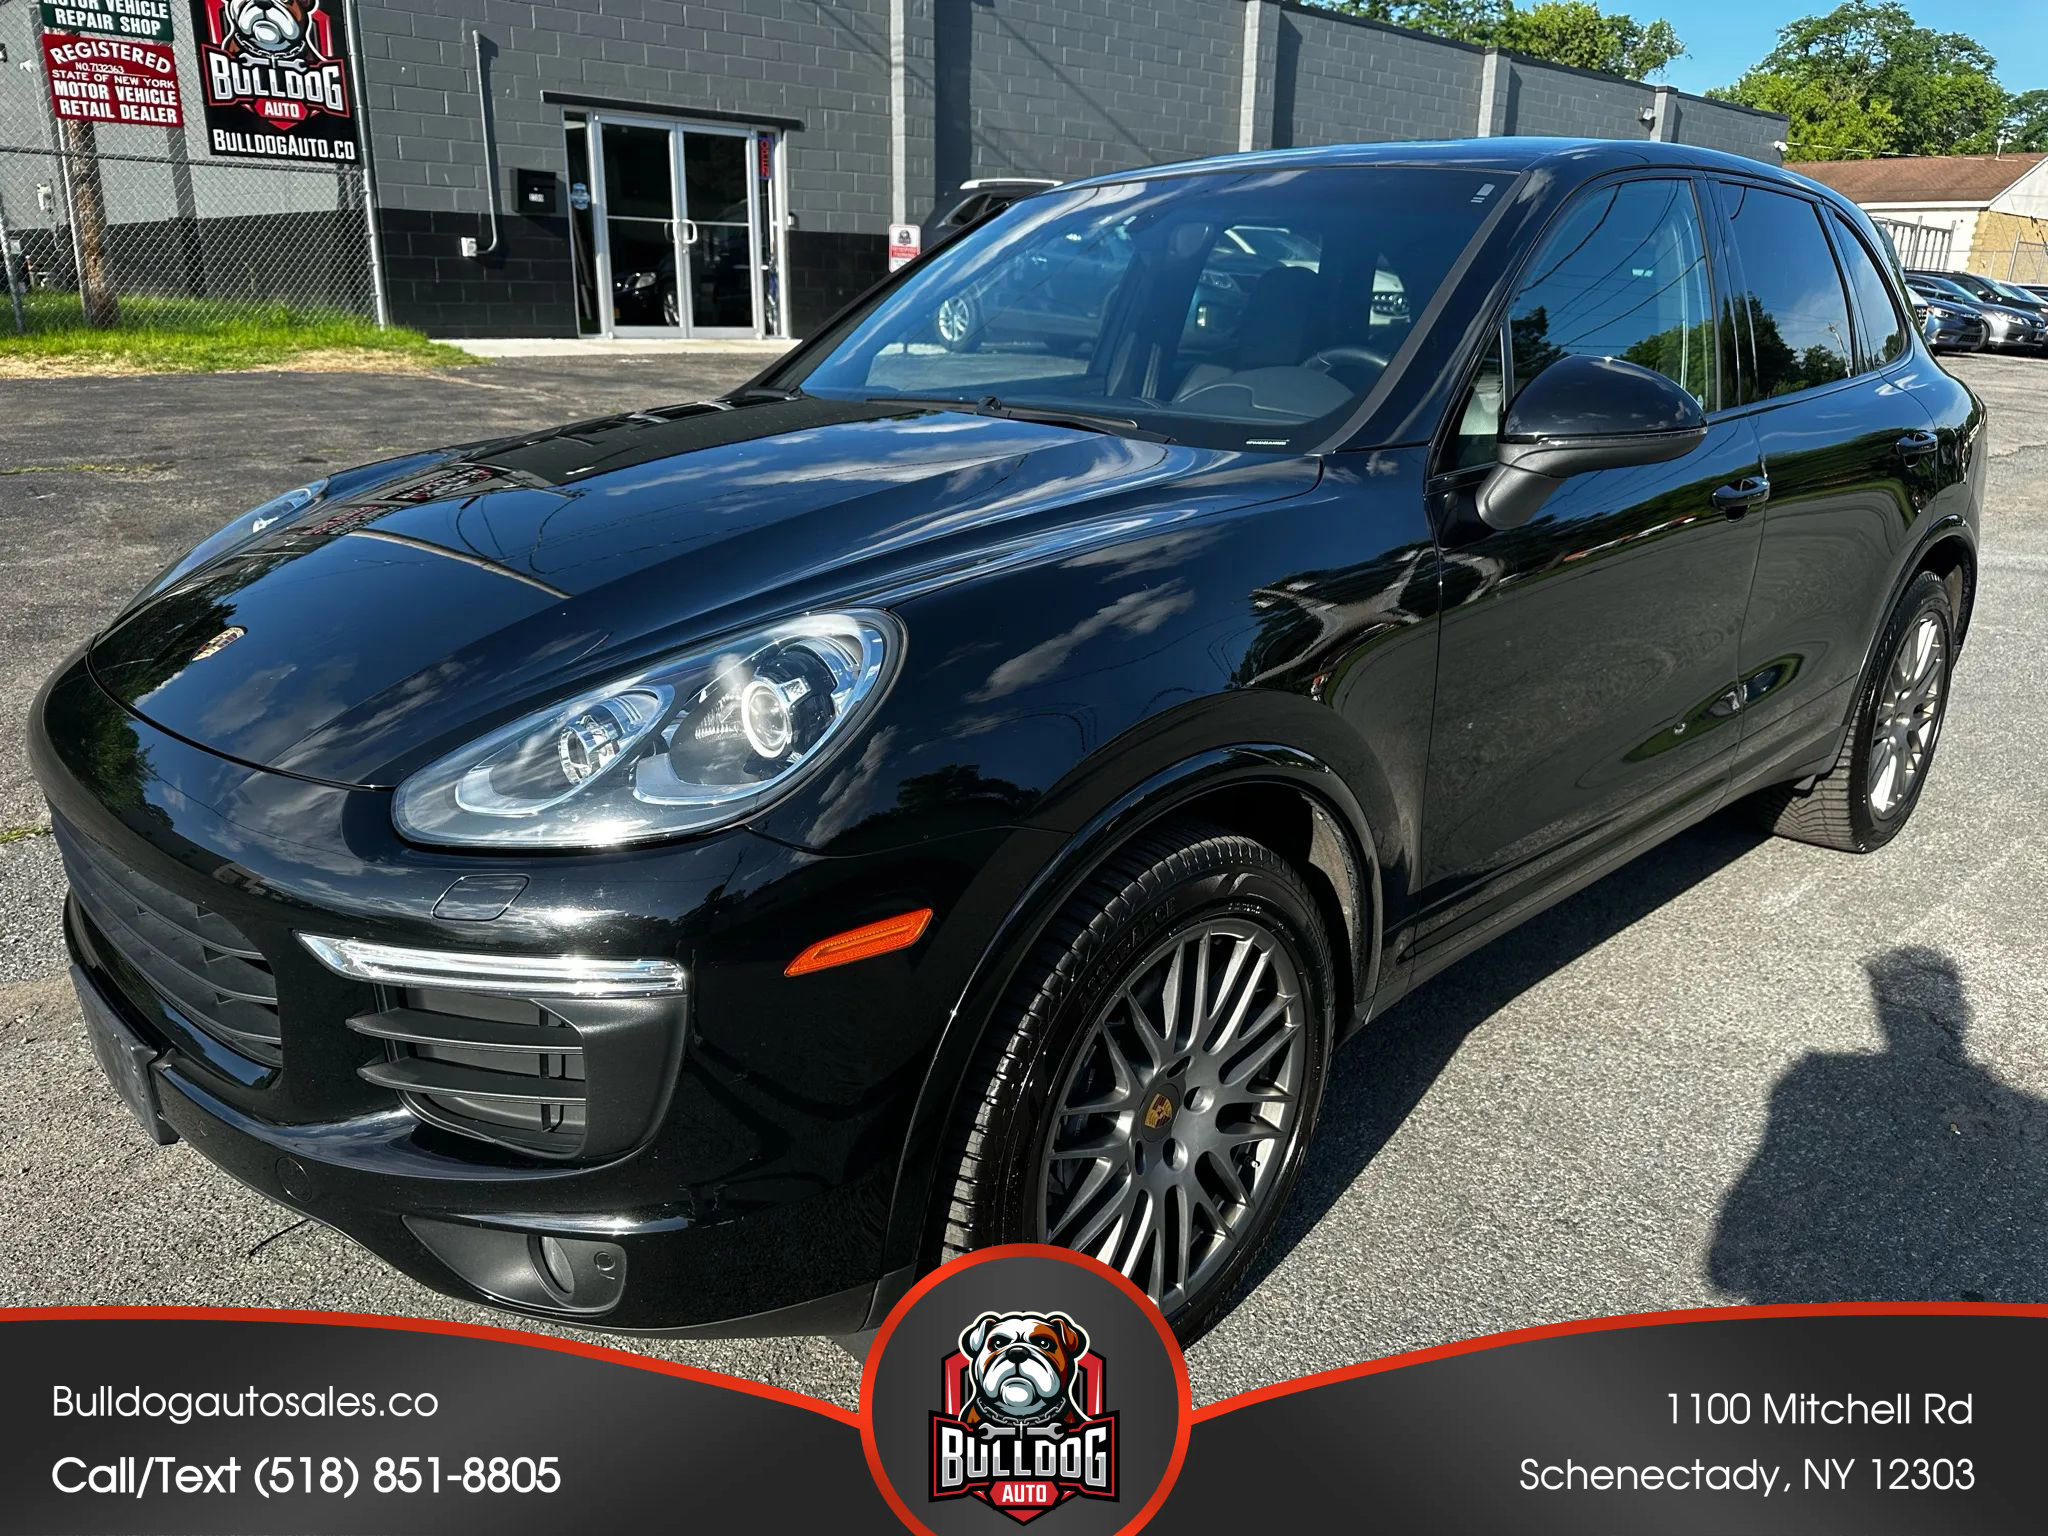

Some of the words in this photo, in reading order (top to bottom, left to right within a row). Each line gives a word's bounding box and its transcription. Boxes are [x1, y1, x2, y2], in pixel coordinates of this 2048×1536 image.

[54, 8, 114, 31] REPAIR
[120, 16, 161, 36] SHOP
[105, 0, 169, 19] VEHICLE
[49, 41, 171, 74] REGISTERED
[51, 69, 89, 81] STATE
[93, 73, 109, 83] OF
[113, 75, 139, 86] NEW
[143, 78, 176, 89] YORK
[208, 52, 344, 112] BULLDOG
[53, 80, 110, 100] MOTOR
[114, 85, 178, 106] VEHICLE
[58, 99, 116, 119] RETAIL
[119, 104, 178, 124] DEALER
[264, 101, 300, 118] AUTO
